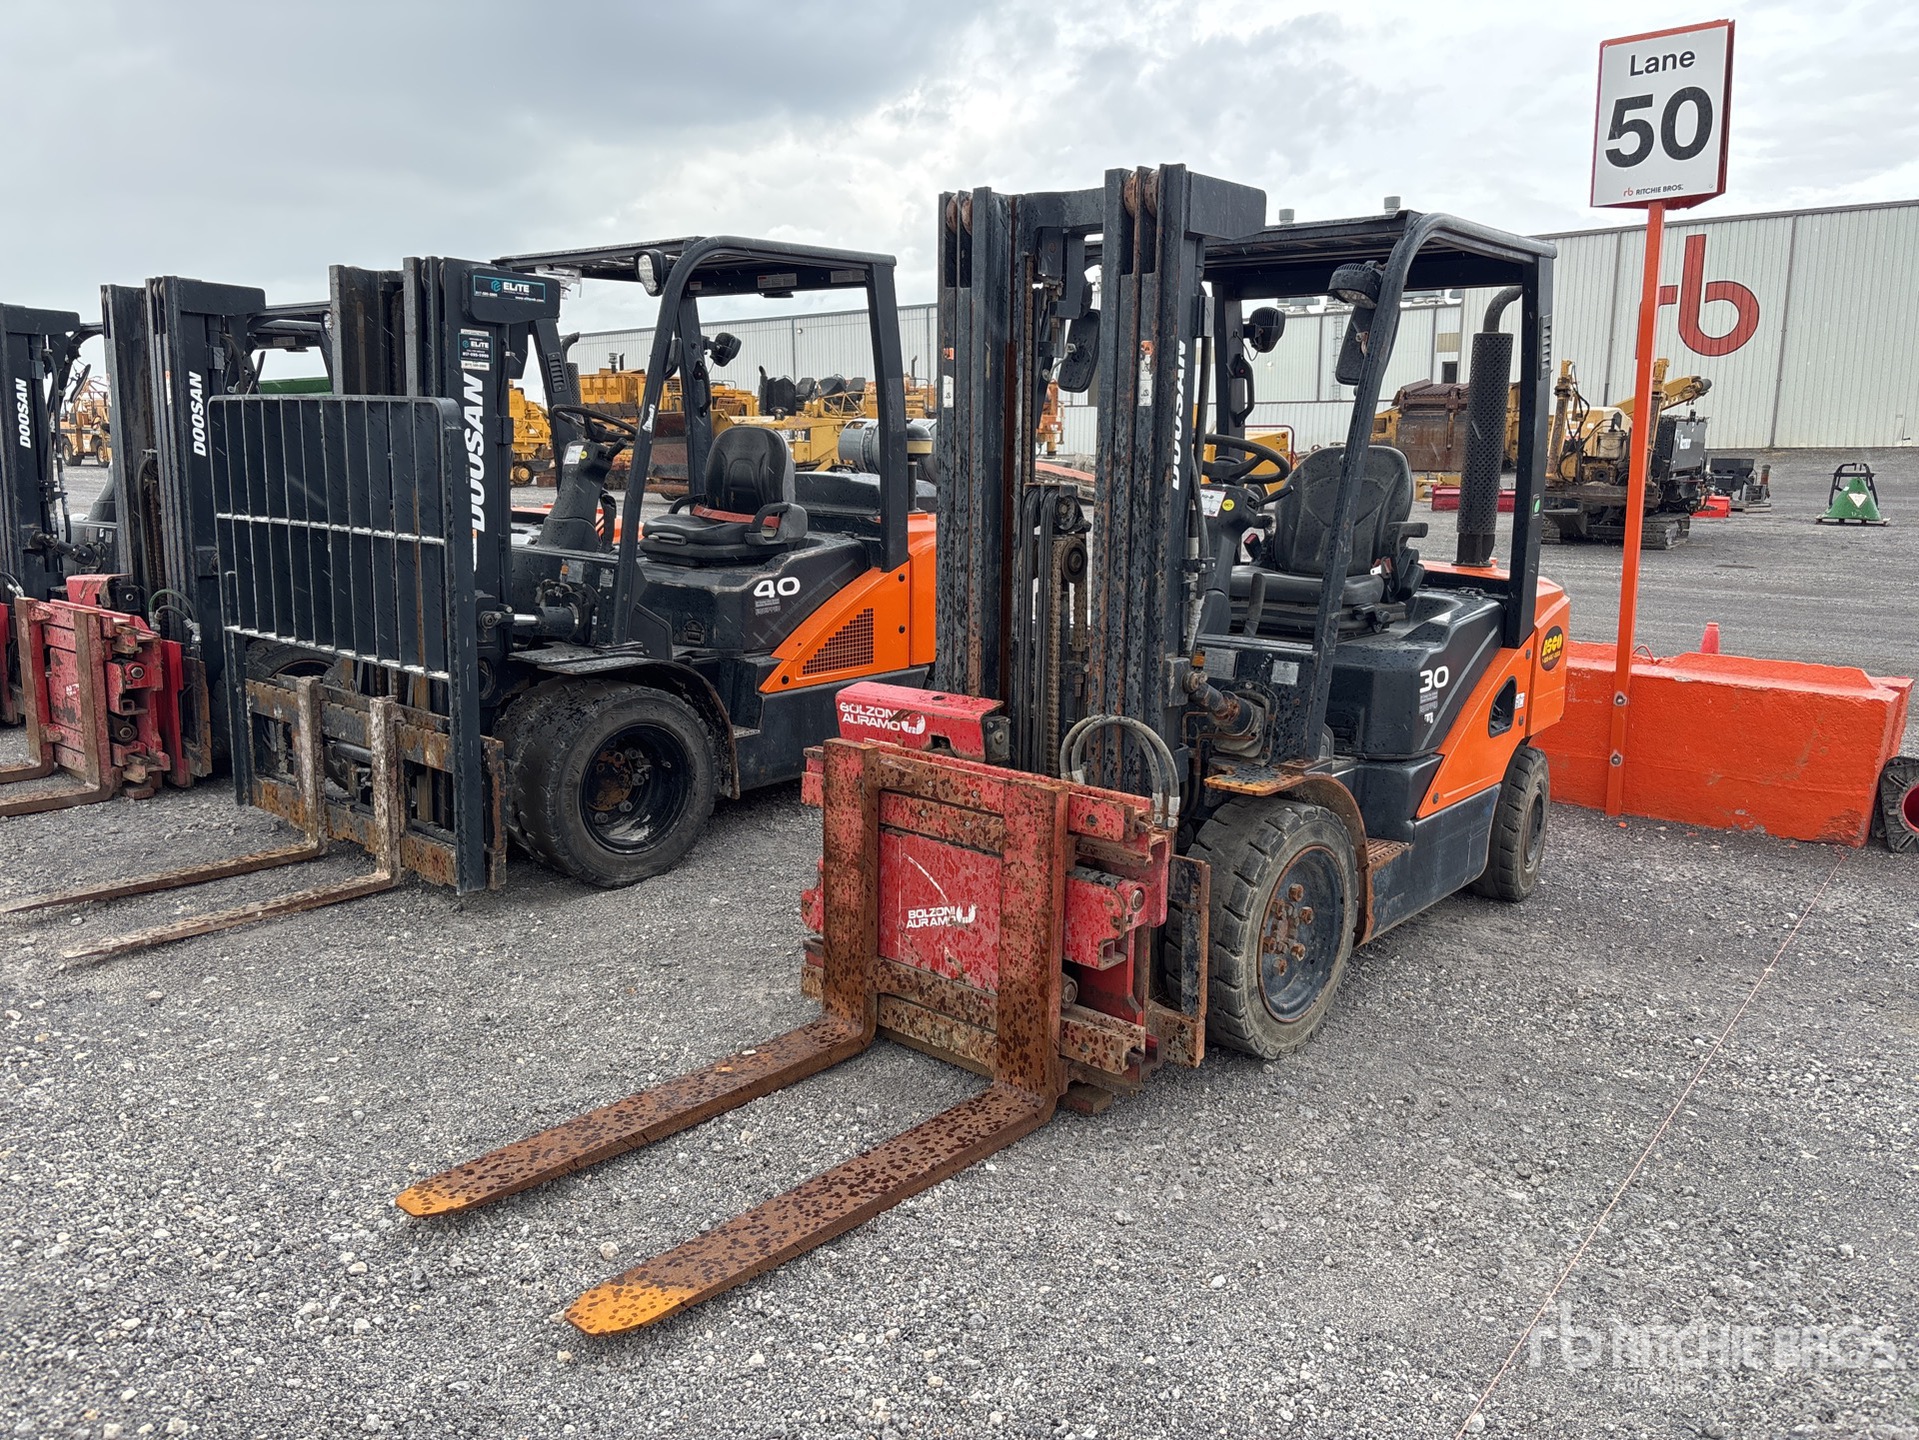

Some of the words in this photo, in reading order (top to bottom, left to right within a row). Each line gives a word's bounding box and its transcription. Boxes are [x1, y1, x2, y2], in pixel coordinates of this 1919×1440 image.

[1630, 50, 1696, 77] Lane
[1605, 86, 1714, 169] 50
[1623, 187, 1634, 197] rb
[1635, 186, 1662, 196] RITCHIE
[503, 281, 530, 293] ELITE
[470, 341, 490, 349] ELITE
[15, 377, 32, 449] DOOSAN
[188, 370, 207, 457] DOOSAN
[463, 371, 486, 533] DOOSAN
[753, 576, 801, 598] 40
[1419, 665, 1450, 694] 30
[840, 702, 900, 718] BOLZON
[842, 713, 901, 732] AURAMO
[907, 905, 956, 920] BOLZONI
